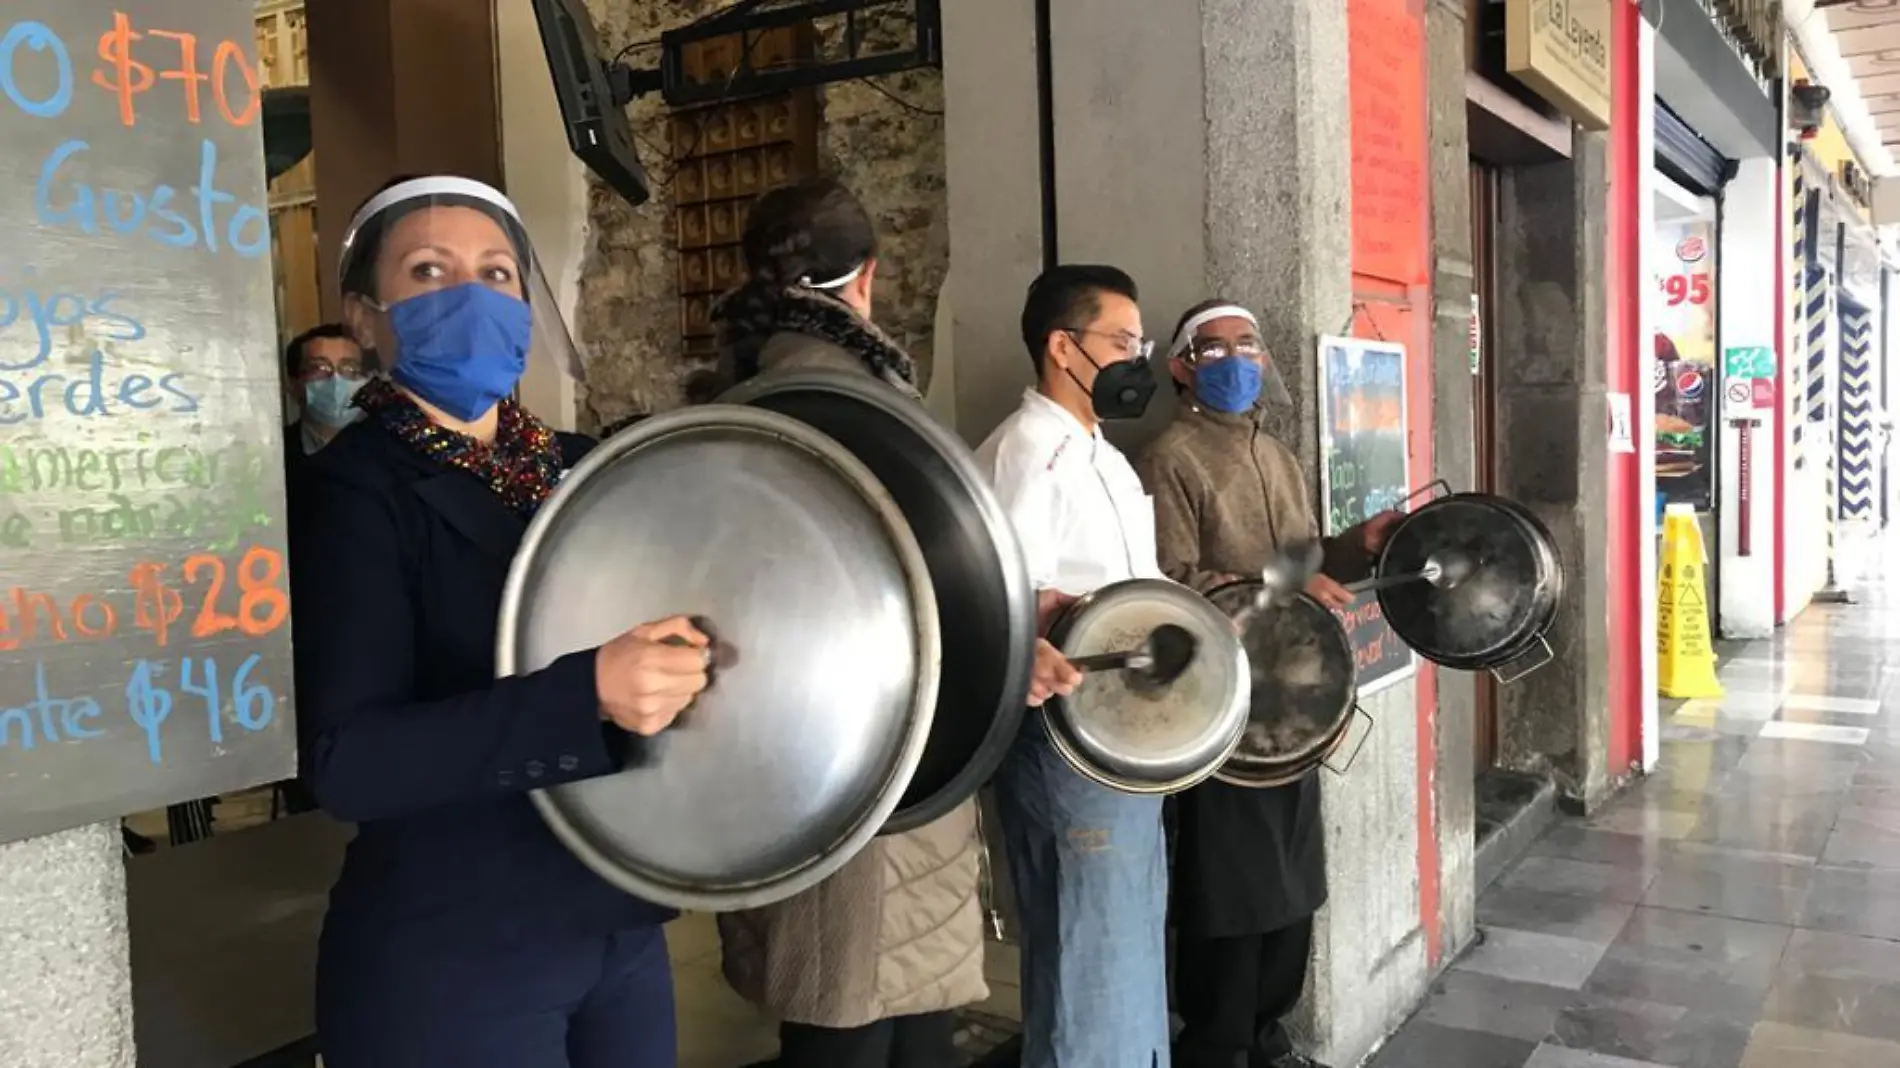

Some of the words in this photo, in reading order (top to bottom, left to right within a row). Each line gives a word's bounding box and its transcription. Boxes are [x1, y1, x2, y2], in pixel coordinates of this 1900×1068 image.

[91, 10, 262, 127] $70
[35, 138, 271, 258] Gusto
[130, 545, 289, 647] $28
[126, 654, 275, 765] $46
